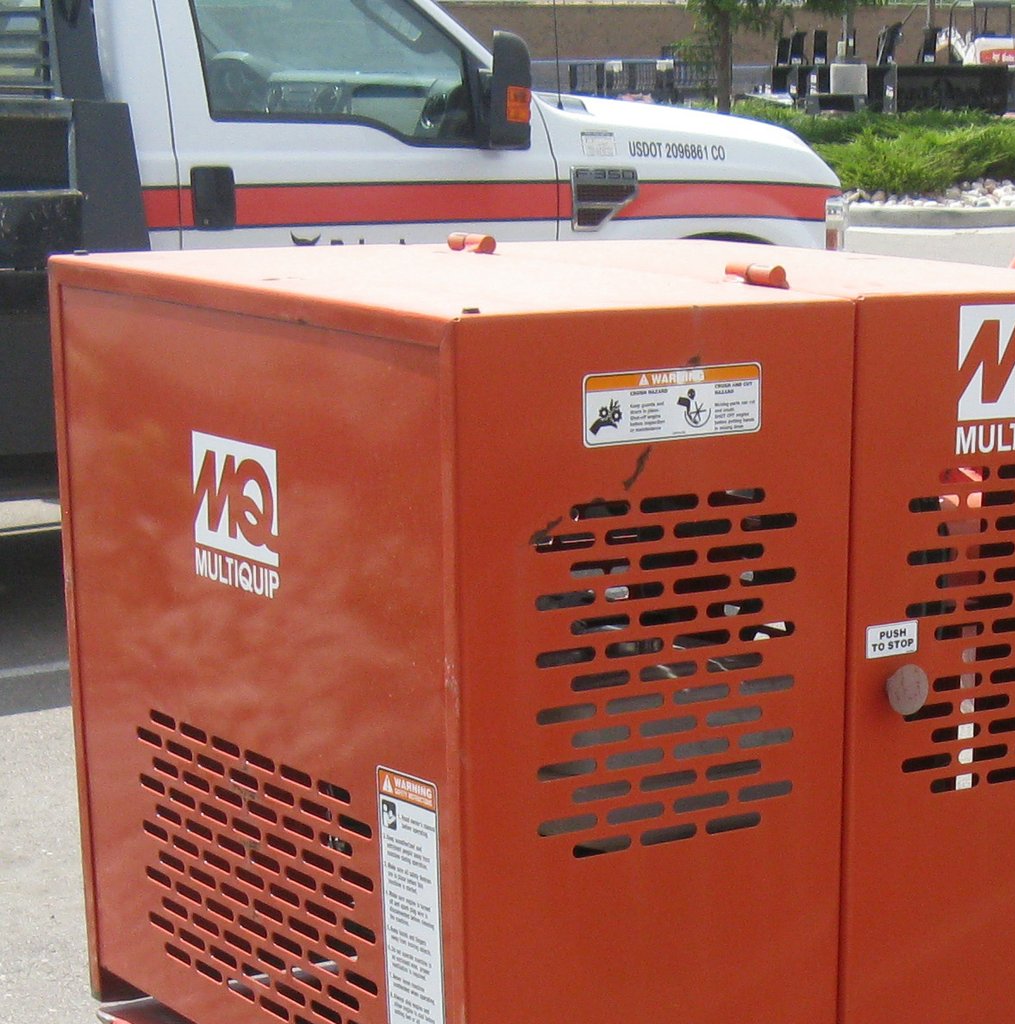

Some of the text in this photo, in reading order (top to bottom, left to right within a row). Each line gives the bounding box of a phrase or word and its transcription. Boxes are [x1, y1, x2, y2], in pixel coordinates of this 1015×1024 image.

[628, 141, 662, 158] USDOT
[666, 143, 709, 161] 2096861
[711, 145, 726, 161] CO
[651, 370, 705, 385] WARIG
[192, 438, 279, 556] MQ
[195, 547, 279, 599] MULTIQUIP
[880, 628, 907, 640] PUSH
[872, 638, 914, 652] TO STOP
[394, 775, 433, 800] WARNING
